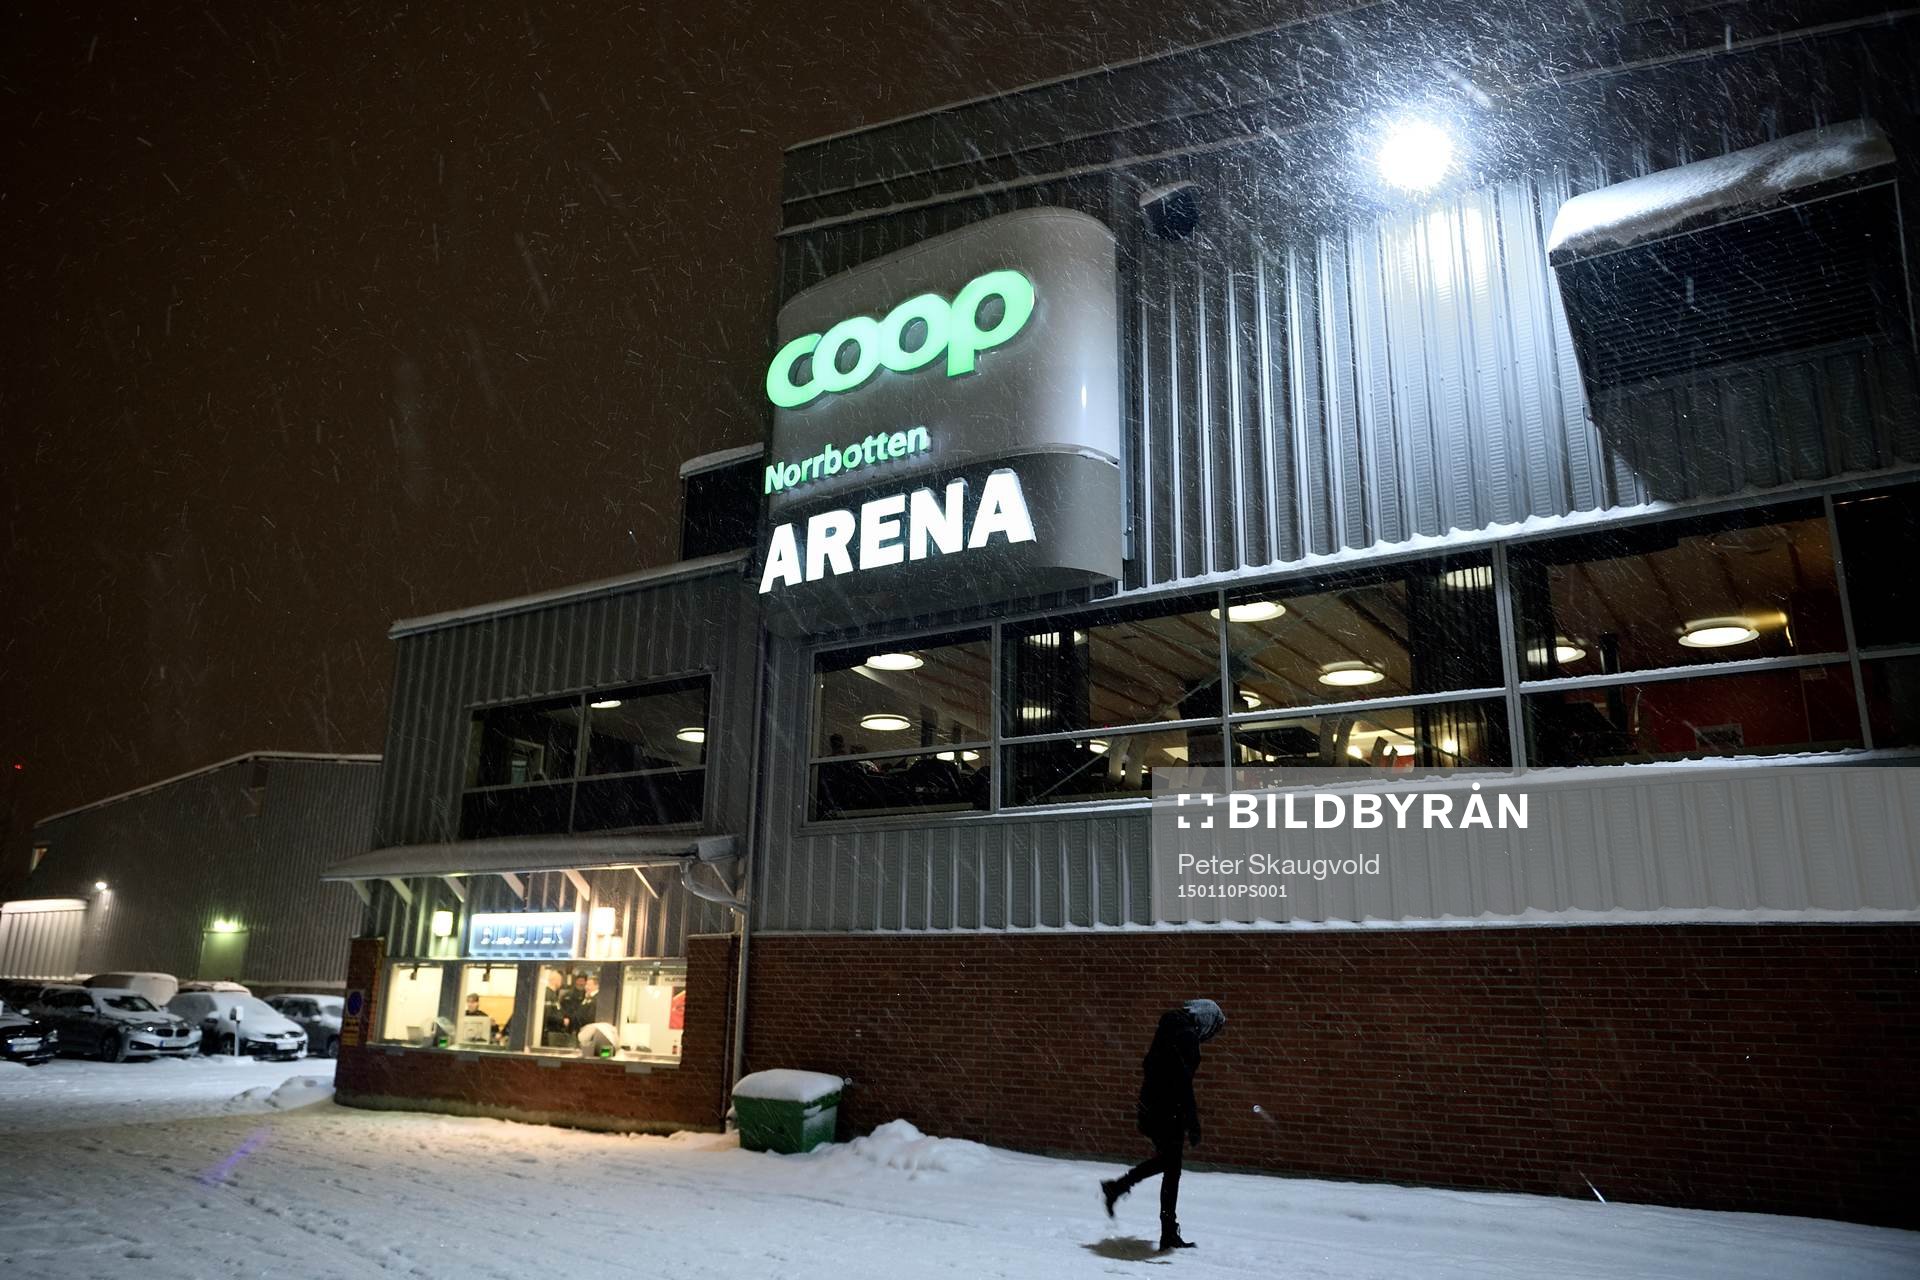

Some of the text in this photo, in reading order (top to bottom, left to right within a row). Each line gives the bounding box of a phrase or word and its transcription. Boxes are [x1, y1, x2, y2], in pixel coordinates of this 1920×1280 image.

[766, 269, 1035, 408] coop
[764, 426, 931, 495] Norrbotten
[758, 467, 1037, 595] ARENA
